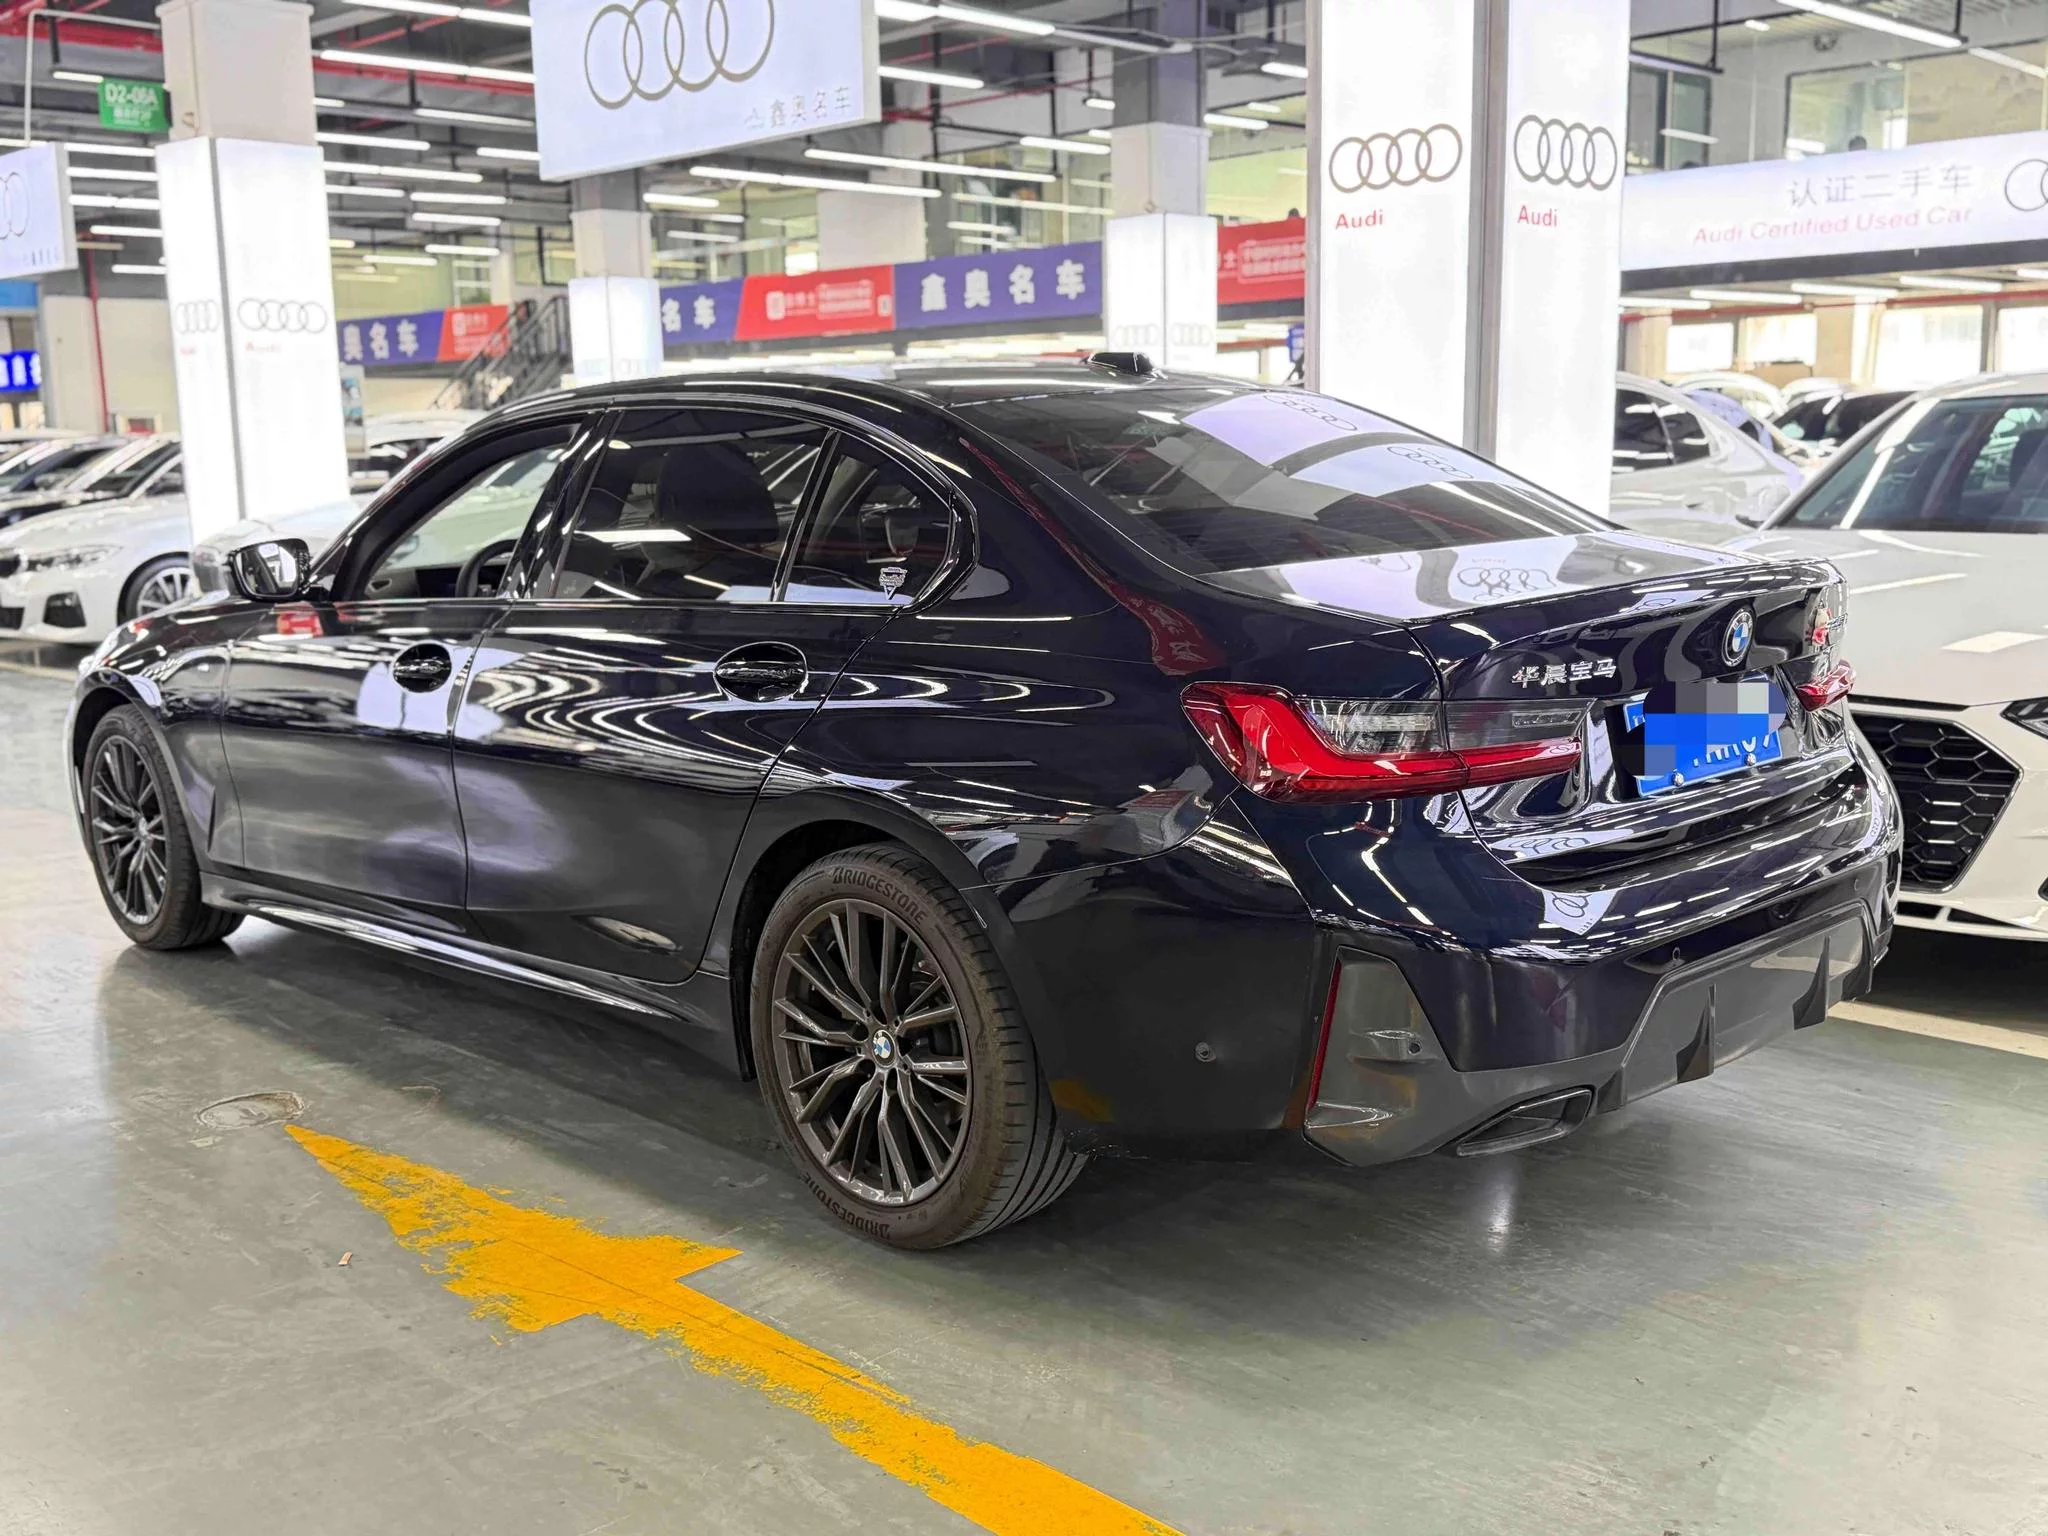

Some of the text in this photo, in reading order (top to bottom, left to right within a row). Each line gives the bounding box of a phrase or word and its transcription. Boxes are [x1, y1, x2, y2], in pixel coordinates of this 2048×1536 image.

[1790, 165, 1974, 208] 认证二手车
[1335, 209, 1384, 230] Audi
[1517, 205, 1558, 227] Audi
[1694, 205, 1972, 245] Audi Certified Used Car
[921, 259, 1085, 312] 鑫奥名车
[1511, 659, 1616, 688] 华晨宝马
[832, 866, 928, 923] BRIDGESTONE
